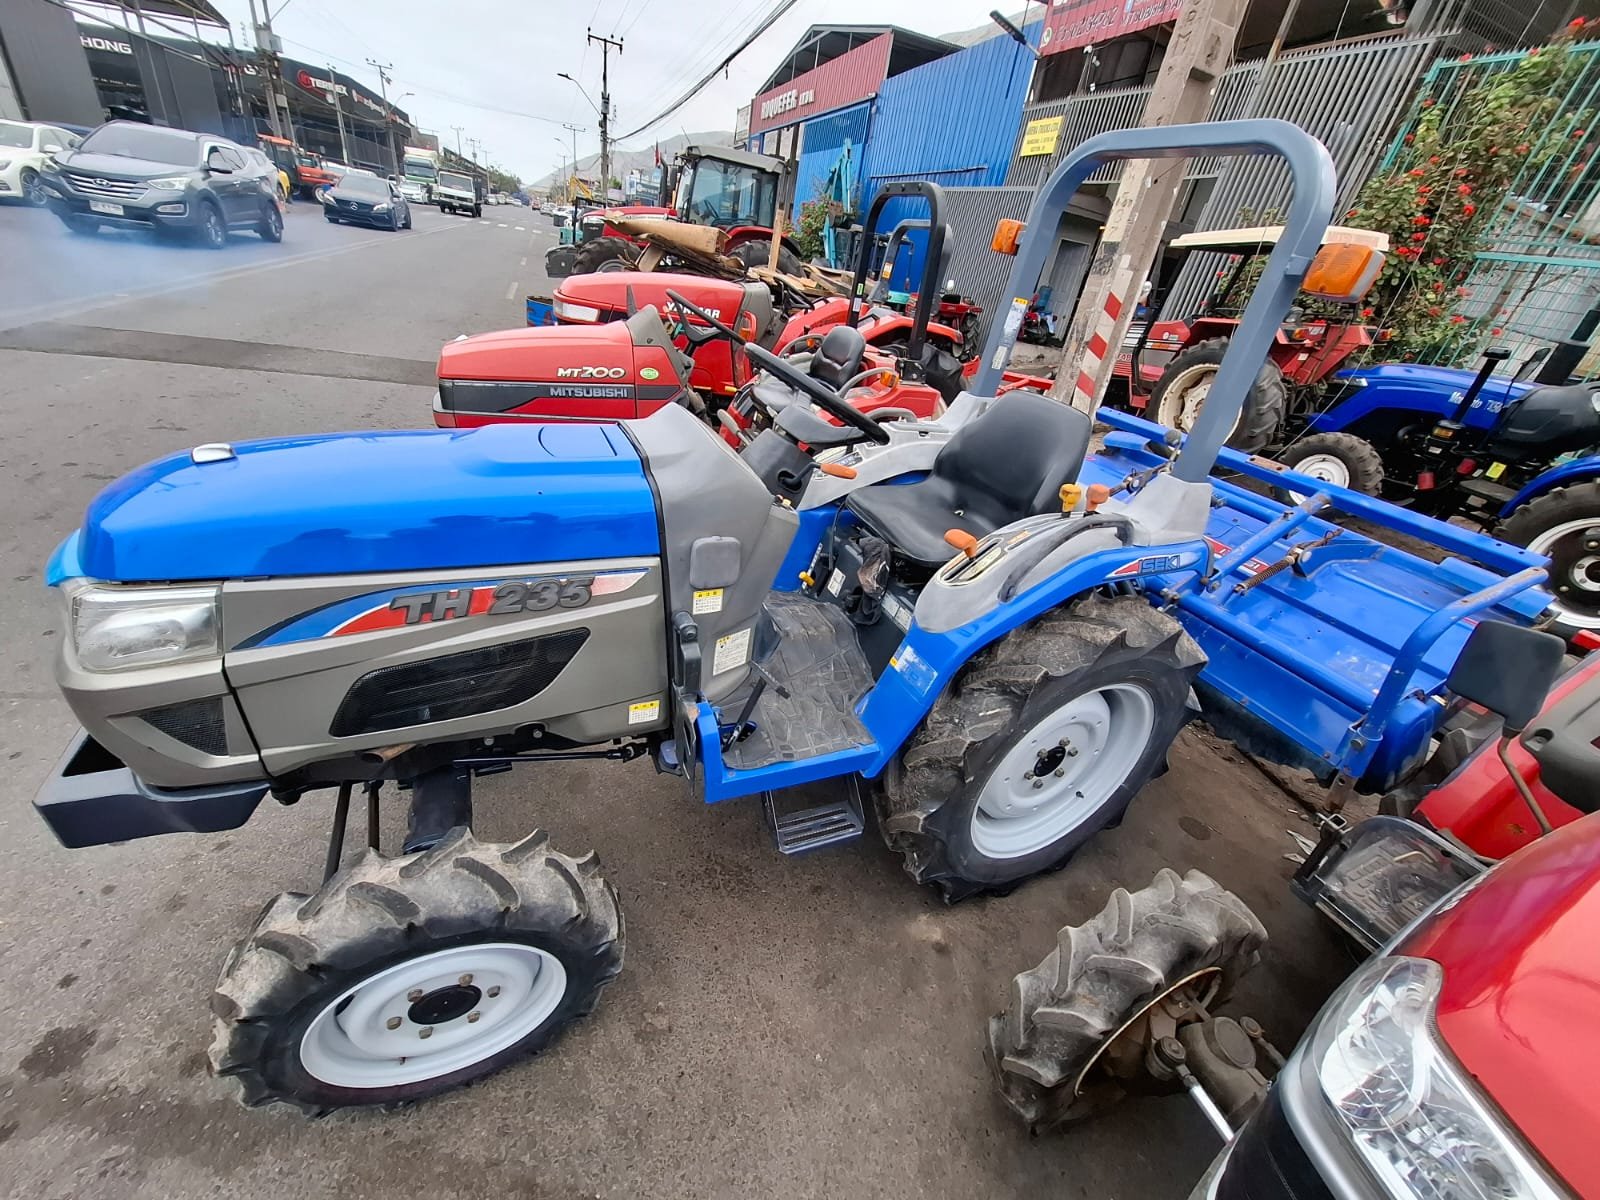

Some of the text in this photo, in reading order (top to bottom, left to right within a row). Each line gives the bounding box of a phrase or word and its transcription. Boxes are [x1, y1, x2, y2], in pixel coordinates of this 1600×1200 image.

[557, 366, 625, 379] MT200
[549, 387, 628, 399] MITSUBISHI
[1138, 555, 1181, 573] ISEKI
[390, 575, 596, 624] TH 235
